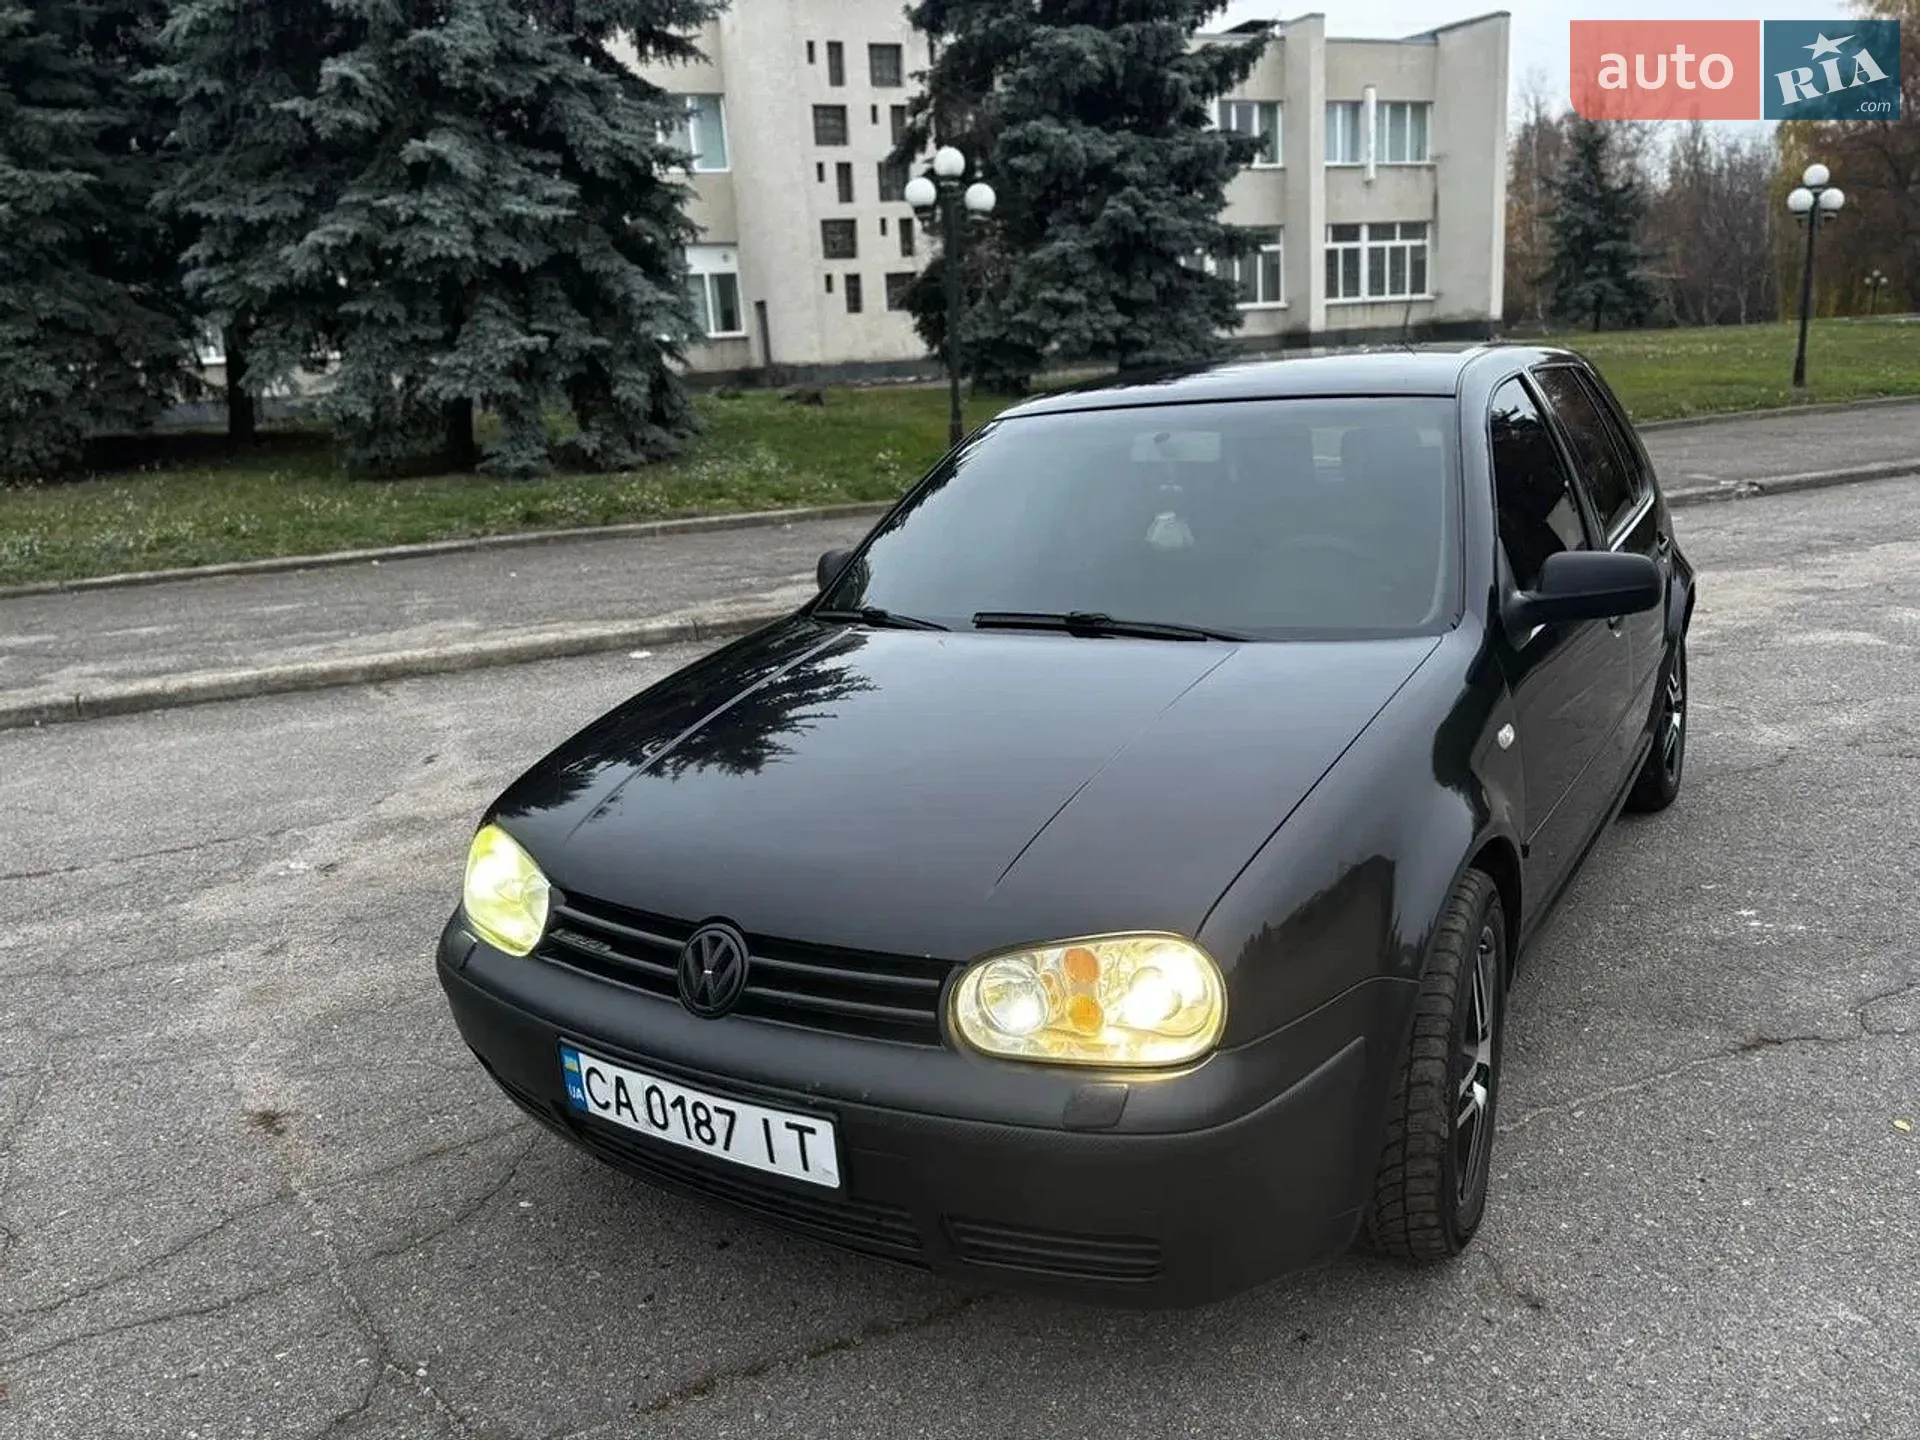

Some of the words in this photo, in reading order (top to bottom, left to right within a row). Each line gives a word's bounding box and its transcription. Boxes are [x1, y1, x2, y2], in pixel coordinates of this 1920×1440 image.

[568, 1082, 585, 1101] UA
[585, 1066, 638, 1123] CA
[645, 1084, 737, 1151] 0187
[762, 1117, 817, 1173] IT
